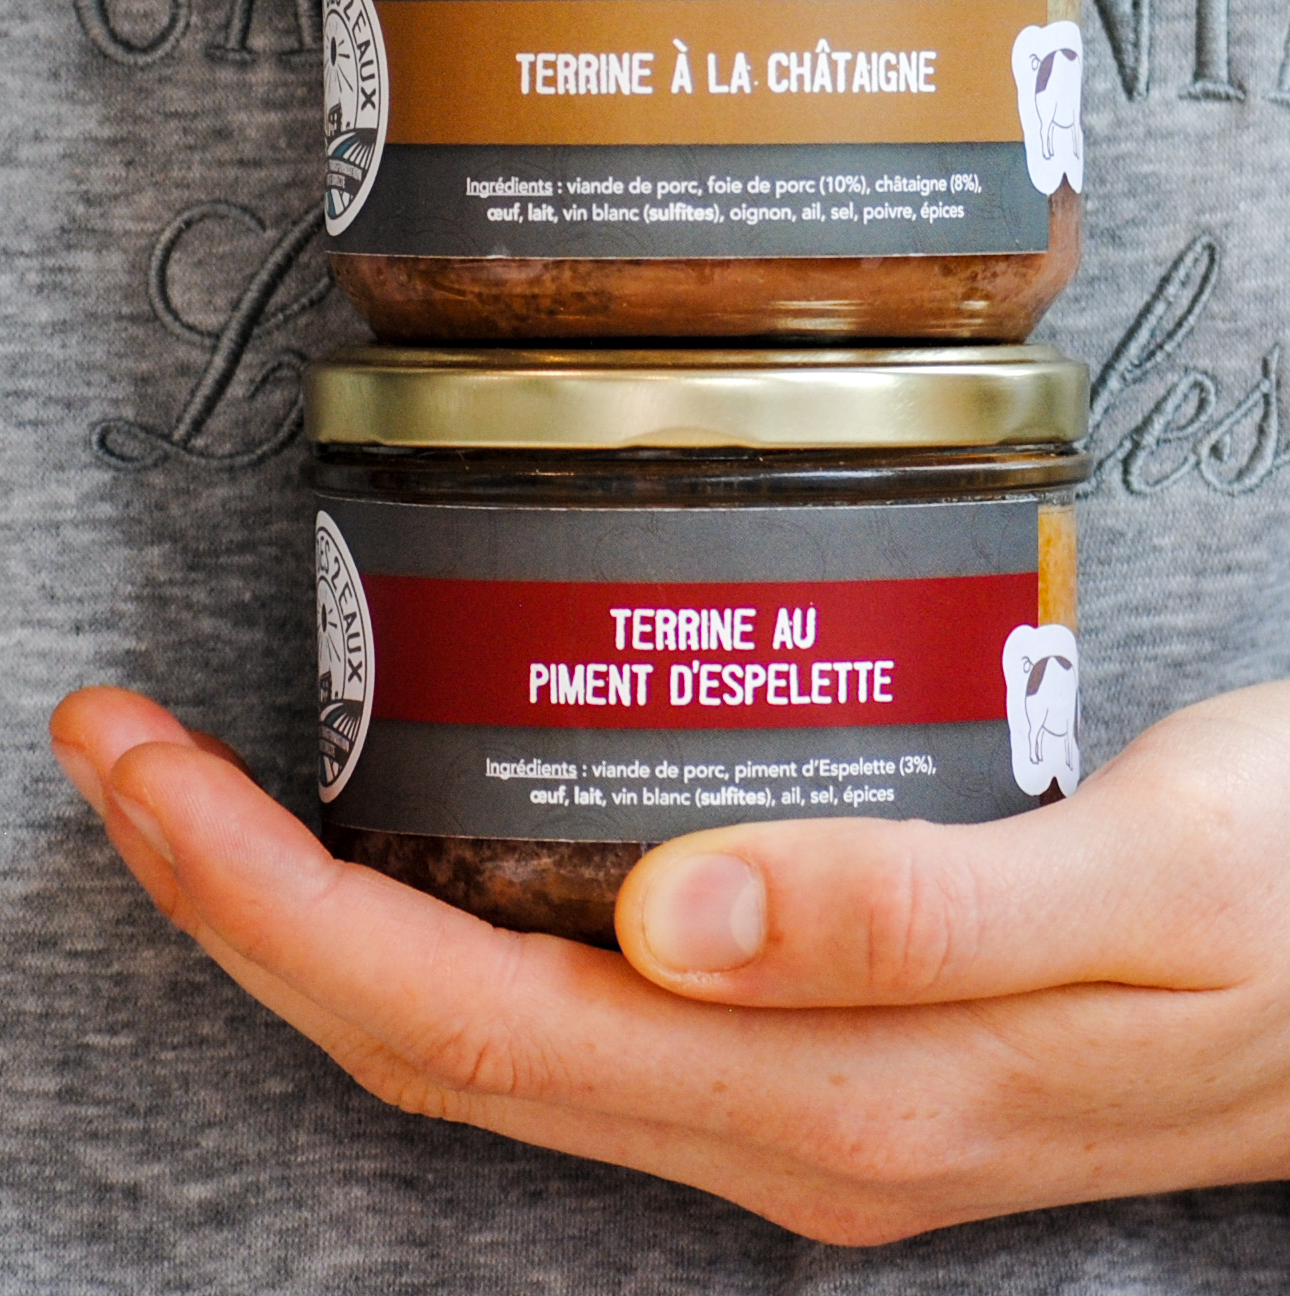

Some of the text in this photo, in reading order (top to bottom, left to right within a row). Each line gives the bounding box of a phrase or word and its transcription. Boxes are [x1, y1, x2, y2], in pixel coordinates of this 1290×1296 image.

[350, 10, 377, 111] EAUX
[516, 38, 936, 95] TERRINE À LA CHÂTAIGNE
[466, 176, 553, 198] Ingrédients
[567, 176, 624, 194] viande
[629, 176, 652, 194] de
[657, 179, 703, 199] porc,
[707, 176, 742, 194] foie
[747, 176, 771, 193] de
[776, 179, 816, 199] porc
[819, 175, 870, 195] (10%),
[875, 174, 947, 196] châtaigne
[950, 173, 982, 194] (8%),
[487, 201, 964, 224] œuf, lait, vin blanc (sulfites), oignon, ail, sel, poivre, épices
[338, 581, 363, 683] EAUX
[610, 607, 816, 651] TERRINE AU
[529, 660, 894, 706] PIMENT D'ESPELETTE
[486, 757, 577, 780] Ingrédients
[592, 760, 650, 778] viande
[655, 760, 679, 778] de
[684, 764, 729, 783] porc,
[735, 761, 798, 783] piment
[802, 757, 895, 781] d'Espelette
[900, 755, 937, 776] (3%),
[530, 785, 894, 808] œuf, lait, vin blanc (sulfites), ail, sel, épices
